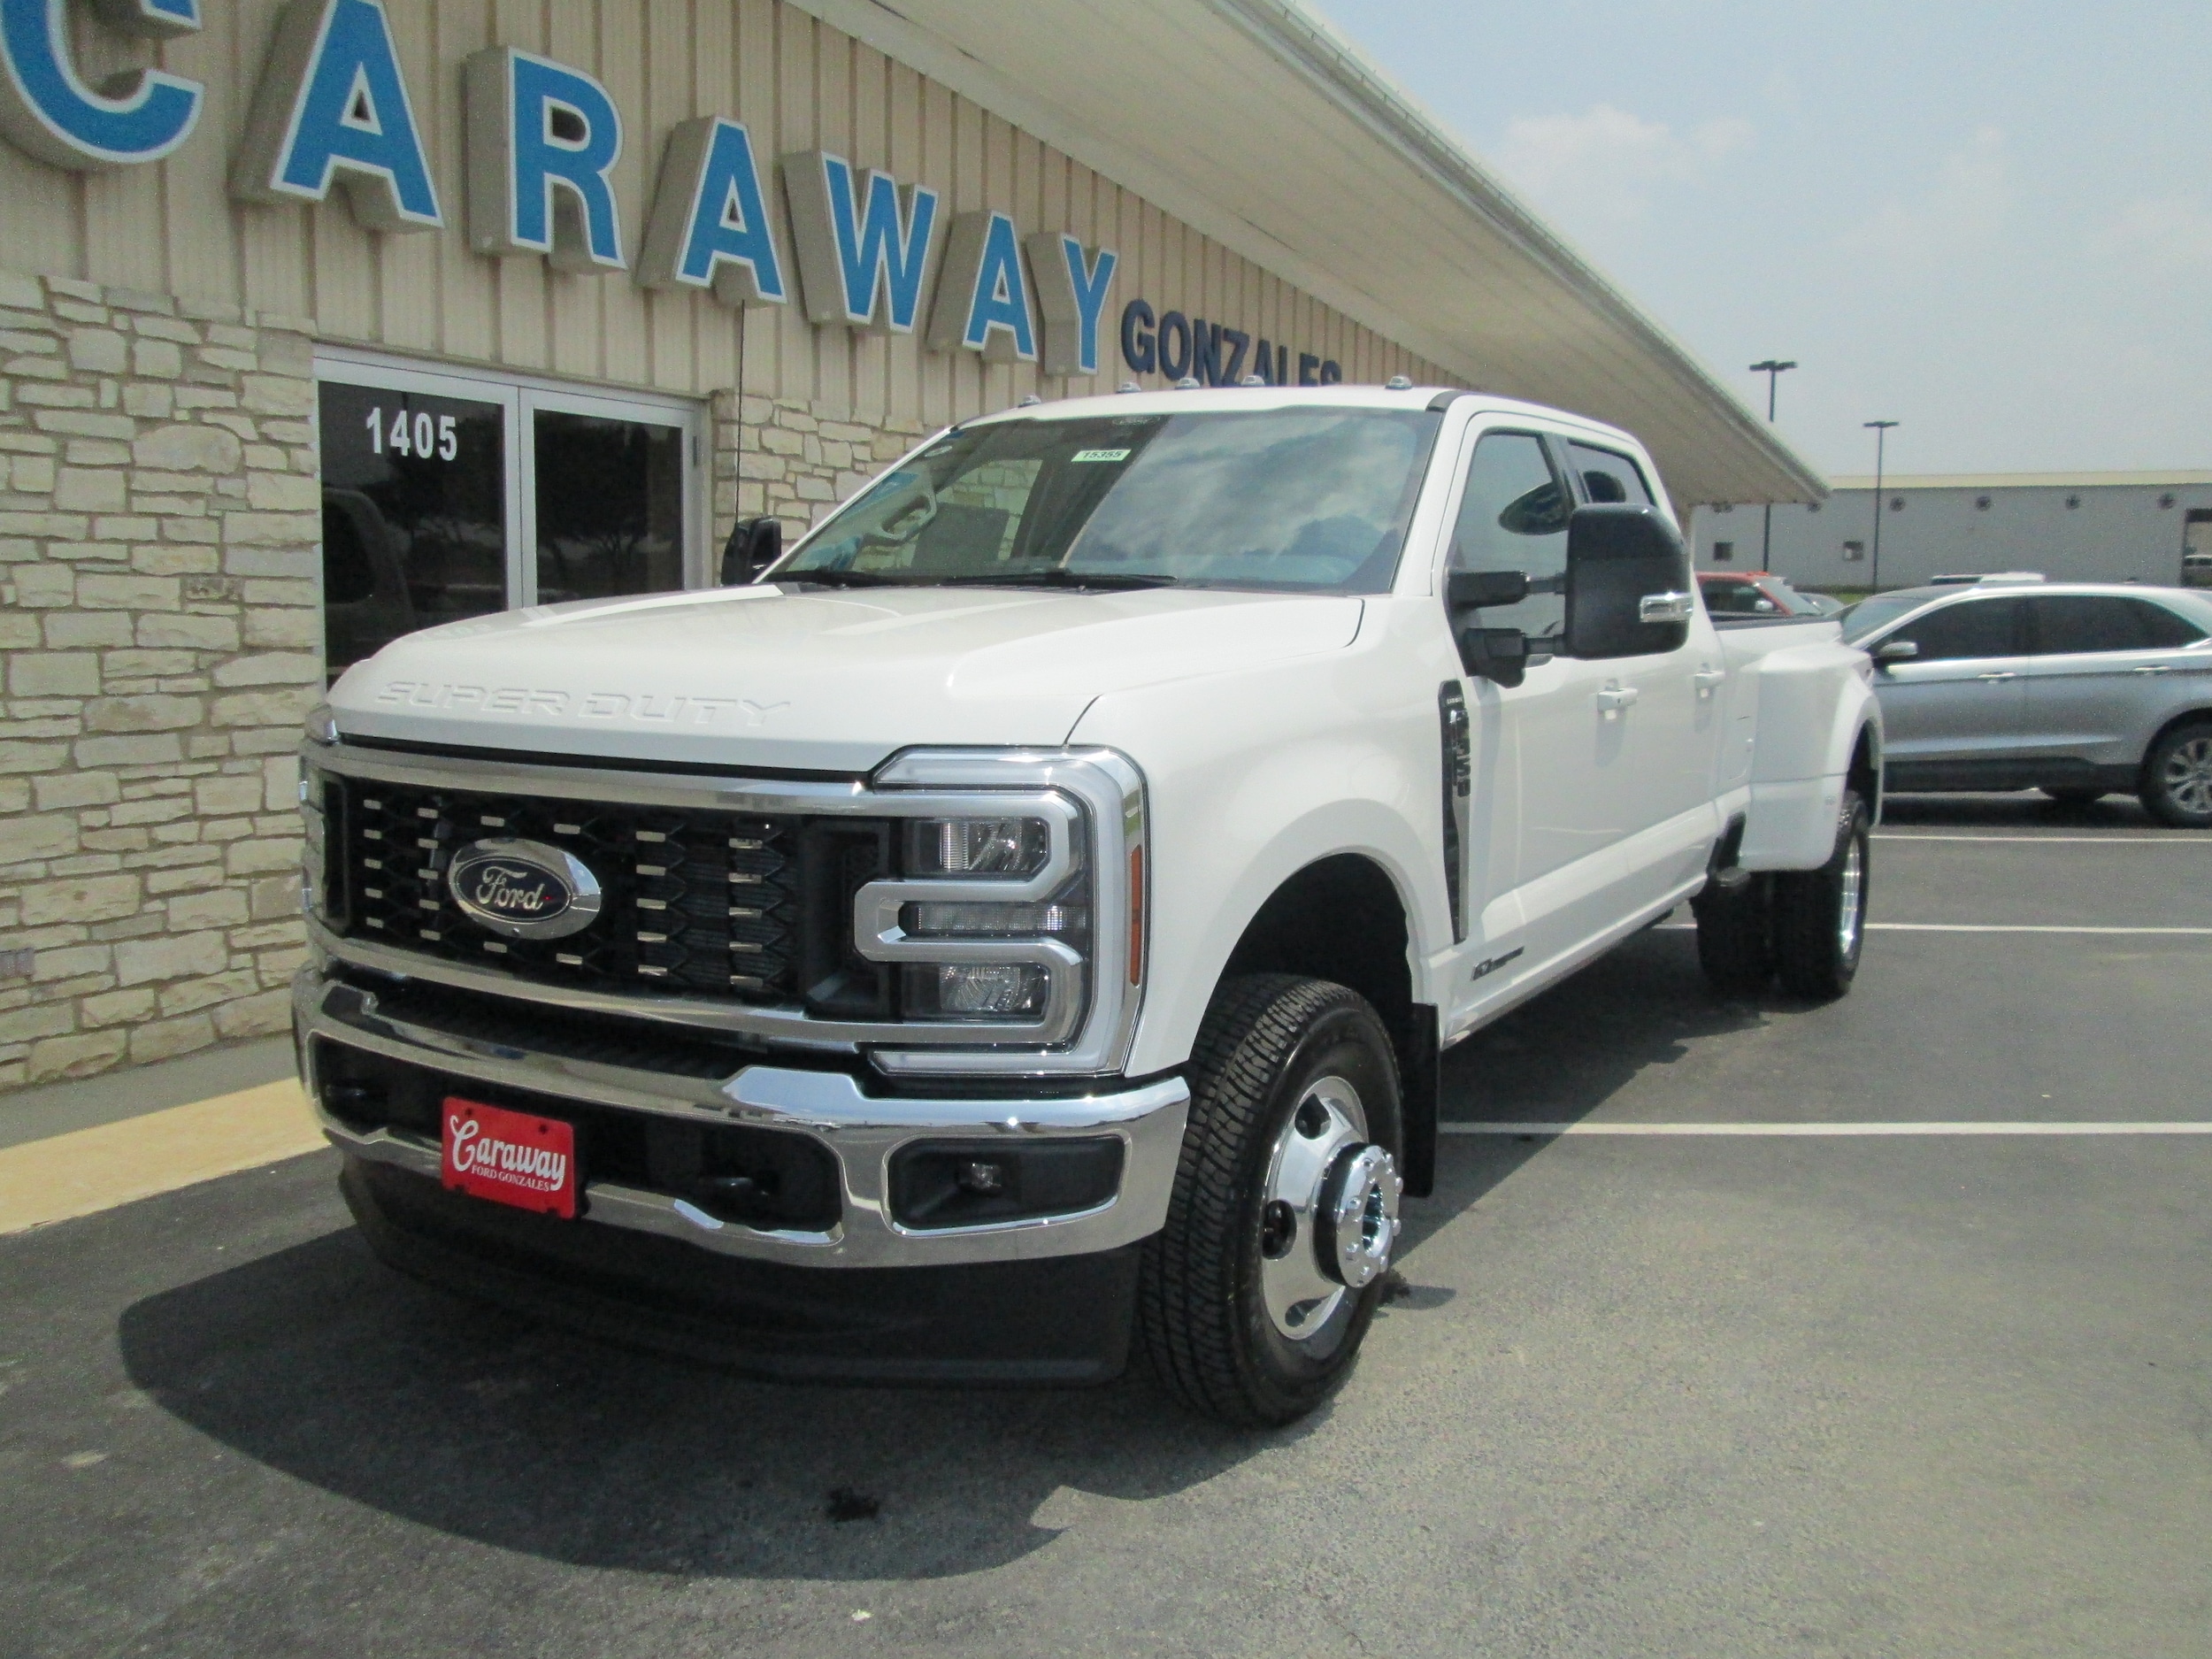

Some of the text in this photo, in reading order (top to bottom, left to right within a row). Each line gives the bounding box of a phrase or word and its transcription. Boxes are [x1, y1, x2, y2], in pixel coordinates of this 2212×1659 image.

[0, 0, 1118, 375] CARAWAY
[366, 406, 457, 461] 1405
[1082, 450, 1124, 459] 15355
[376, 680, 791, 727] SUPER DUTY
[475, 865, 546, 910] Ford
[449, 1115, 566, 1191] Caraway
[472, 1164, 551, 1192] FORD GONZALES
